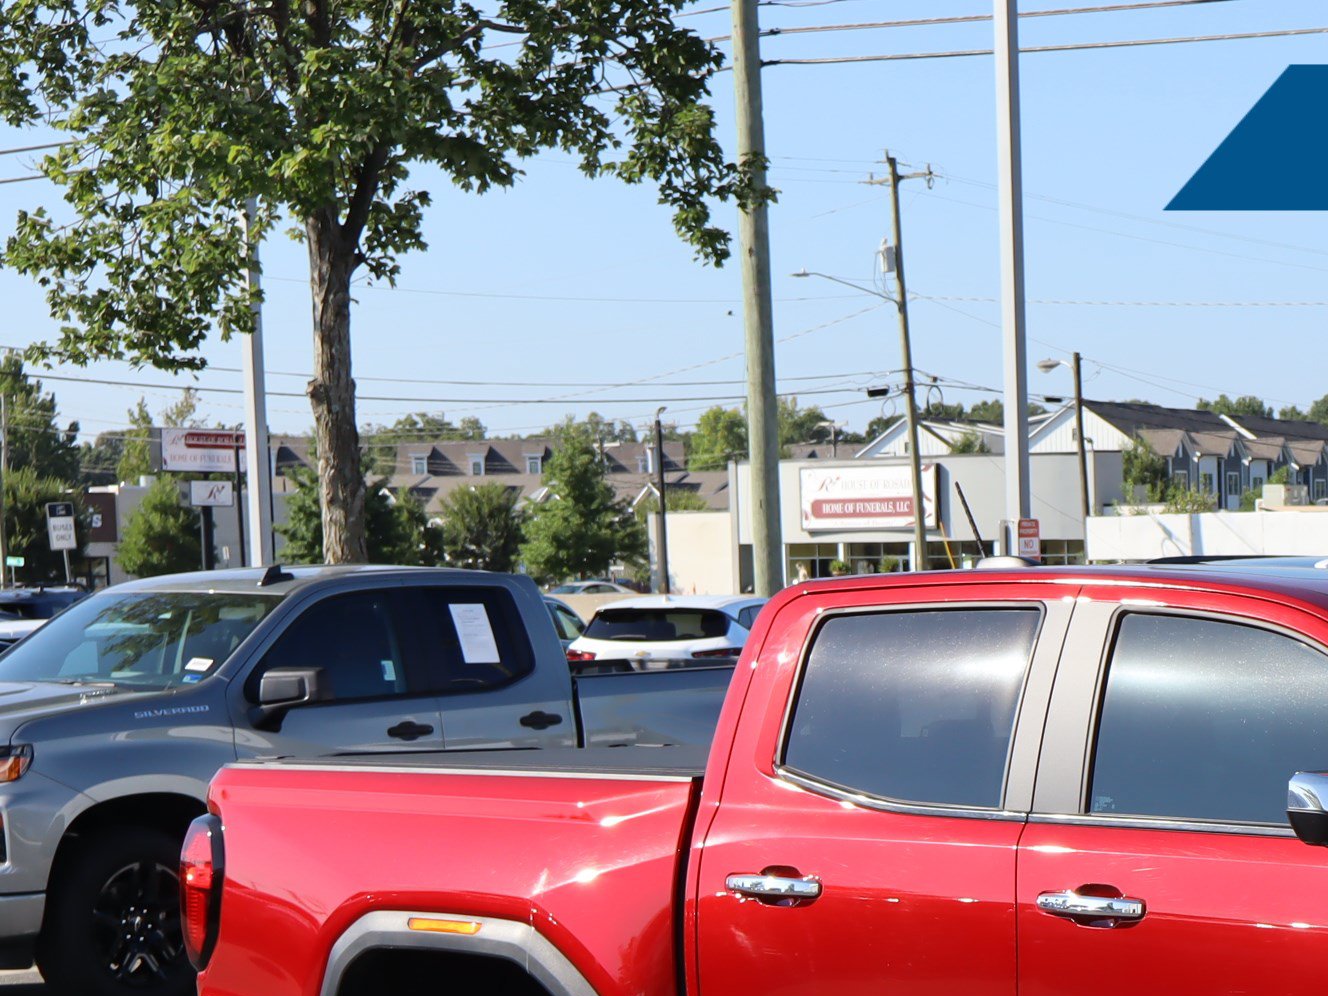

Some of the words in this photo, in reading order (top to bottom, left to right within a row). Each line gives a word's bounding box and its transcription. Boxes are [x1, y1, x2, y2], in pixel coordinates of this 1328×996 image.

[822, 503, 844, 514] HOME
[845, 503, 854, 514] OF
[856, 501, 896, 514] FUNERALS,
[897, 501, 910, 513] LLC
[134, 704, 210, 719] SILVERADO
